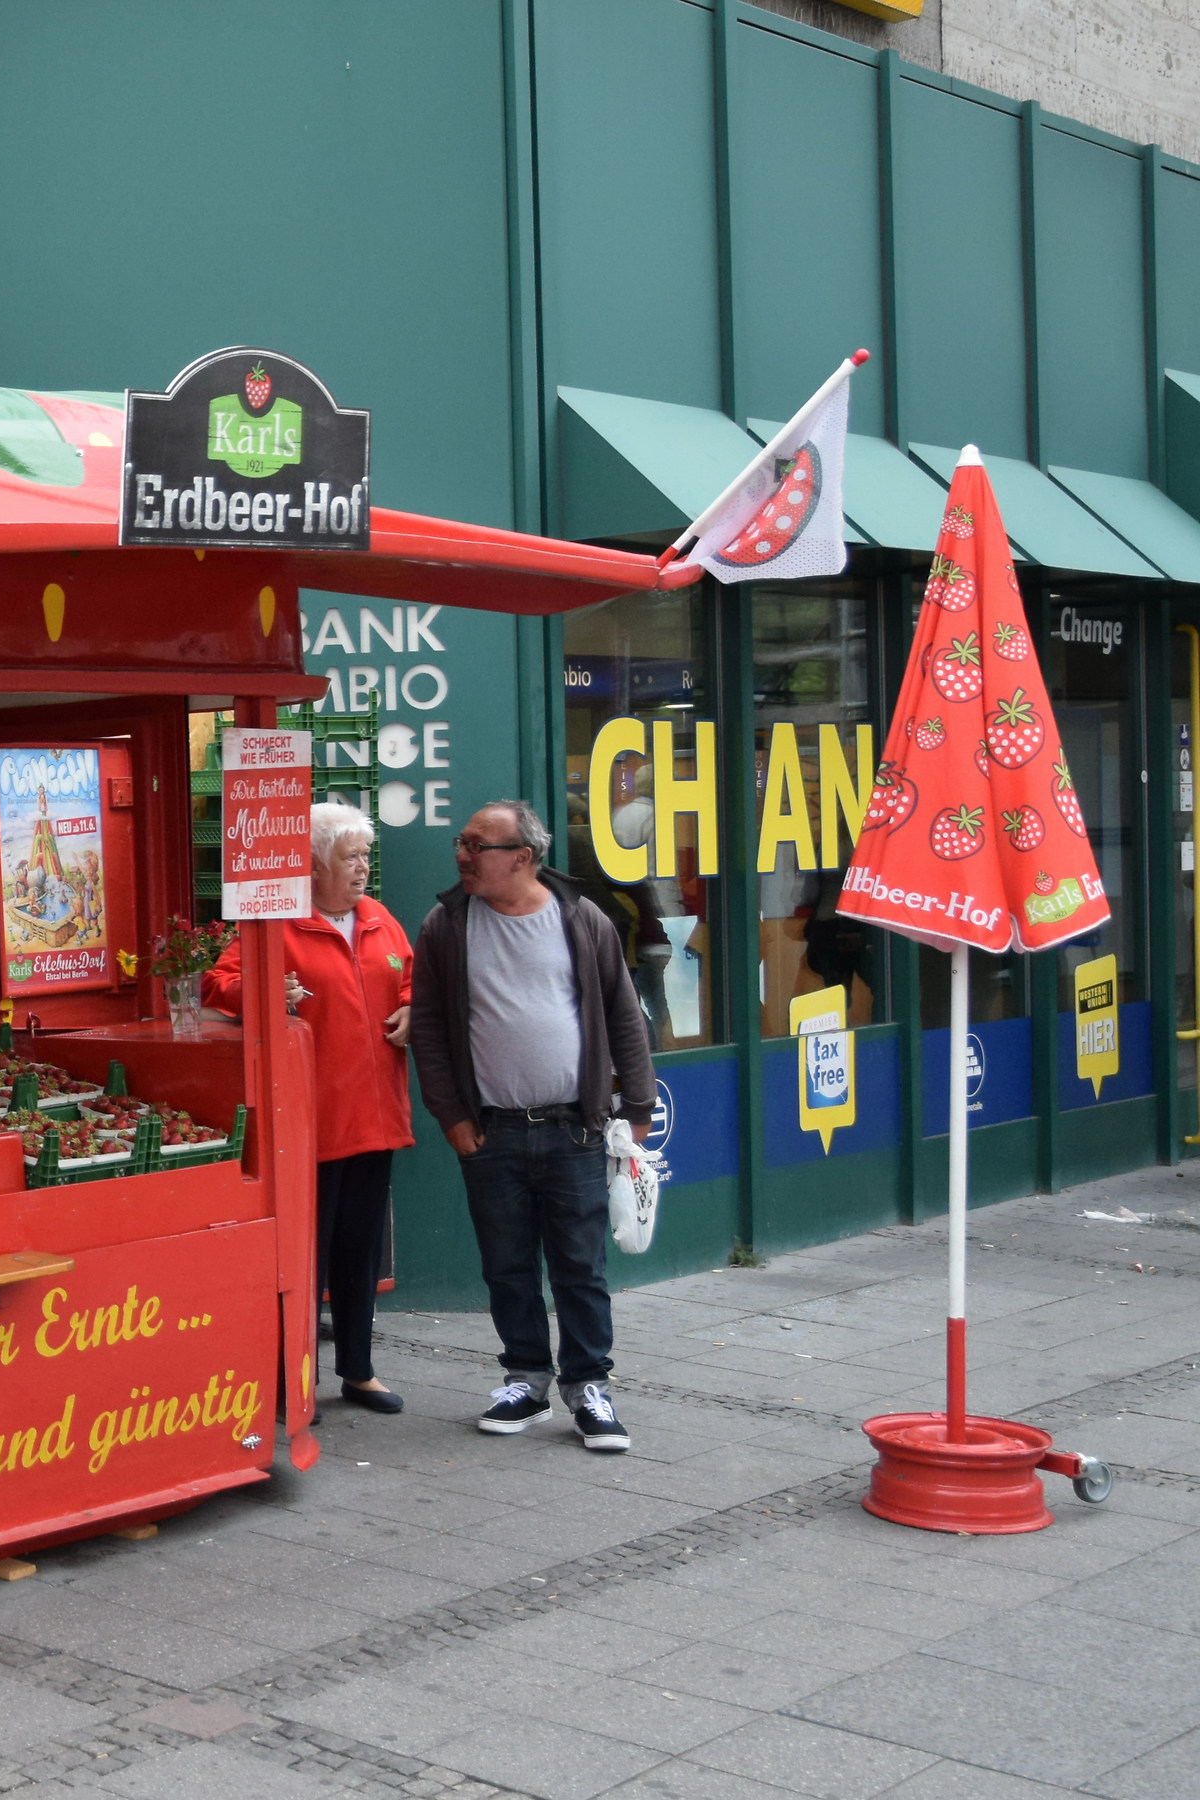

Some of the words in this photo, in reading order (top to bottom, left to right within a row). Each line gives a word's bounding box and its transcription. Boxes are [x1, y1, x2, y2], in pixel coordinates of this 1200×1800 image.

[213, 411, 297, 457] Karls
[245, 459, 264, 473] 1921
[133, 473, 362, 536] Erdbeer-Hof
[1060, 606, 1123, 655] Change
[242, 735, 292, 750] SCHMECKT
[240, 752, 257, 765] WIE
[259, 748, 295, 764] FRÜHER
[230, 779, 257, 800] Die
[258, 777, 305, 798] köstliche
[58, 820, 71, 835] NEU
[80, 818, 96, 832] 11.6.
[227, 805, 309, 849] Malwina
[249, 849, 285, 871] wieder
[287, 848, 303, 868] da
[252, 884, 282, 899] JETZT
[240, 897, 297, 915] PROBIEREN
[1026, 886, 1083, 921] Karls
[9, 962, 32, 977] Karls
[33, 950, 106, 973] Erlebnis-Dorf
[45, 972, 61, 981] Elstal
[62, 971, 70, 979] bei
[72, 970, 88, 979] Berlin
[1079, 985, 1108, 1001] WESTERN
[1087, 994, 1108, 1009] UNION
[804, 1014, 838, 1031] PREMIER
[813, 1036, 839, 1062] tax
[1079, 1018, 1116, 1057] HIER
[813, 1064, 845, 1091] free
[34, 1284, 164, 1358] Ernte
[87, 1368, 262, 1474] günstig
